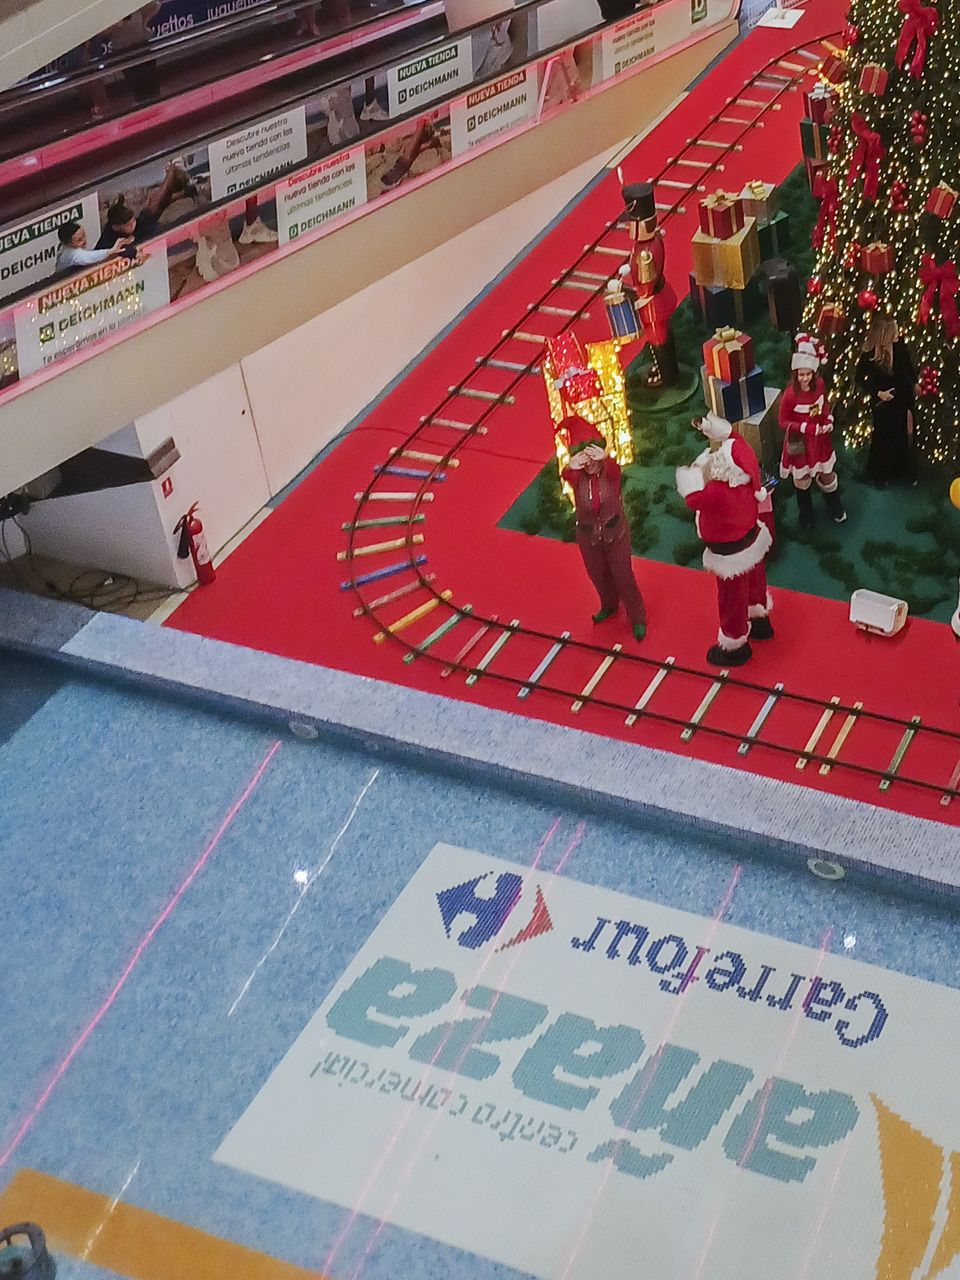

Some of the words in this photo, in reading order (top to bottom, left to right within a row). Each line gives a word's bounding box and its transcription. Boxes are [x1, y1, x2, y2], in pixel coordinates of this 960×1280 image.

[400, 61, 428, 80] NUEVA
[428, 47, 457, 66] TIENDA
[408, 68, 459, 98] DEICHMANN
[468, 84, 497, 106] NUEVA
[497, 71, 525, 91] TIENDA
[477, 93, 527, 125] DEICHMANN
[222, 148, 245, 163] nueva
[245, 137, 269, 154] tienda
[269, 133, 283, 143] con
[283, 126, 293, 137] las
[226, 127, 261, 149] Descubre
[261, 116, 288, 134] nuestra
[253, 141, 291, 162] tendencias
[283, 187, 307, 203] nueva
[307, 175, 330, 193] tienda
[331, 170, 345, 181] con
[344, 163, 356, 174] las
[288, 163, 322, 187] Descubre
[322, 152, 350, 171] nuestra
[314, 178, 353, 201] tendencias
[32, 207, 80, 236] TIENDA
[300, 196, 356, 233] DEICHMANN
[1, 243, 62, 281] DEICHM
[41, 275, 91, 308] NUEVA
[58, 280, 145, 332] DEICHMANN
[570, 916, 889, 1049] Carrefour
[309, 1051, 469, 1117] comercial
[324, 955, 861, 1183] añaza
[472, 1102, 579, 1153] centro
